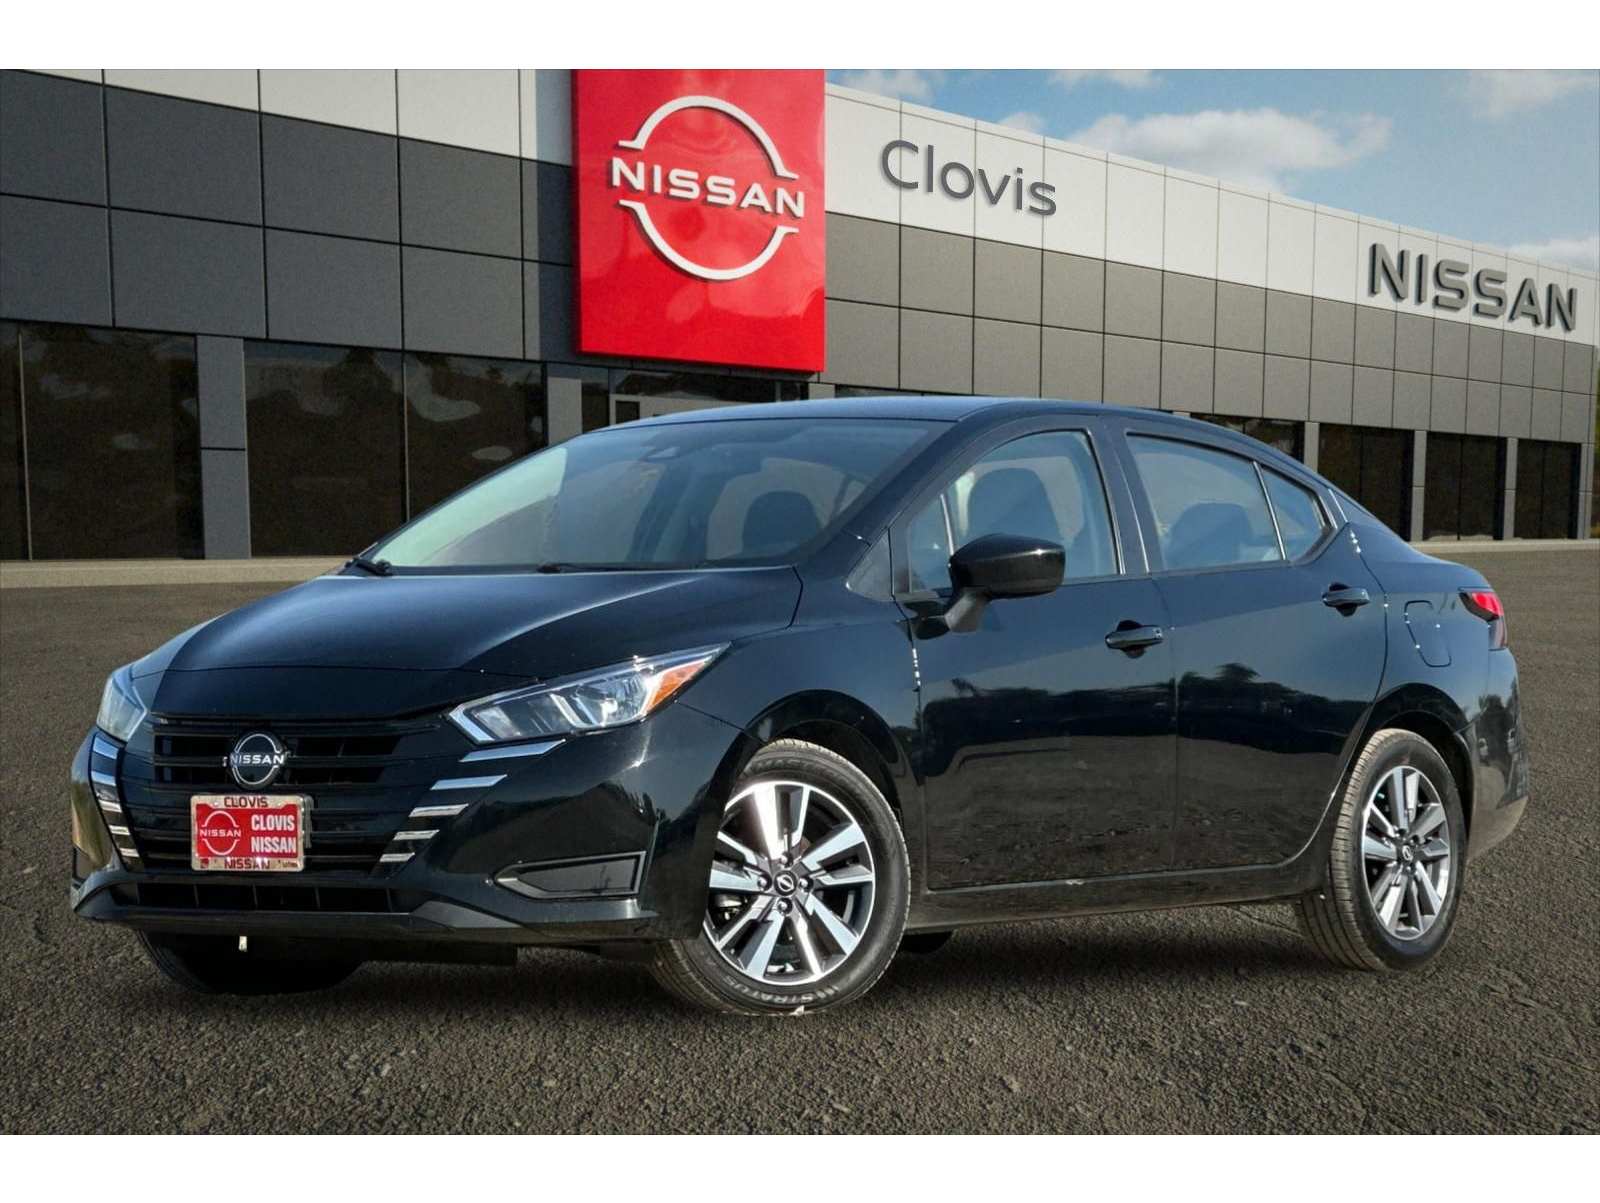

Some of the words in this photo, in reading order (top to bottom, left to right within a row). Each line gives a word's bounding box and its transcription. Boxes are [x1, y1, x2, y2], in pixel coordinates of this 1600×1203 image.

[881, 139, 1057, 216] Clovis
[610, 155, 805, 219] NISSAN
[1368, 242, 1578, 332] NISSAN
[229, 755, 285, 765] NISSAN
[224, 797, 268, 808] CLOVIS
[251, 814, 295, 831] CLOVIS
[200, 829, 241, 837] NISSAN
[251, 837, 296, 853] NISSAN
[224, 857, 270, 869] NISSAN
